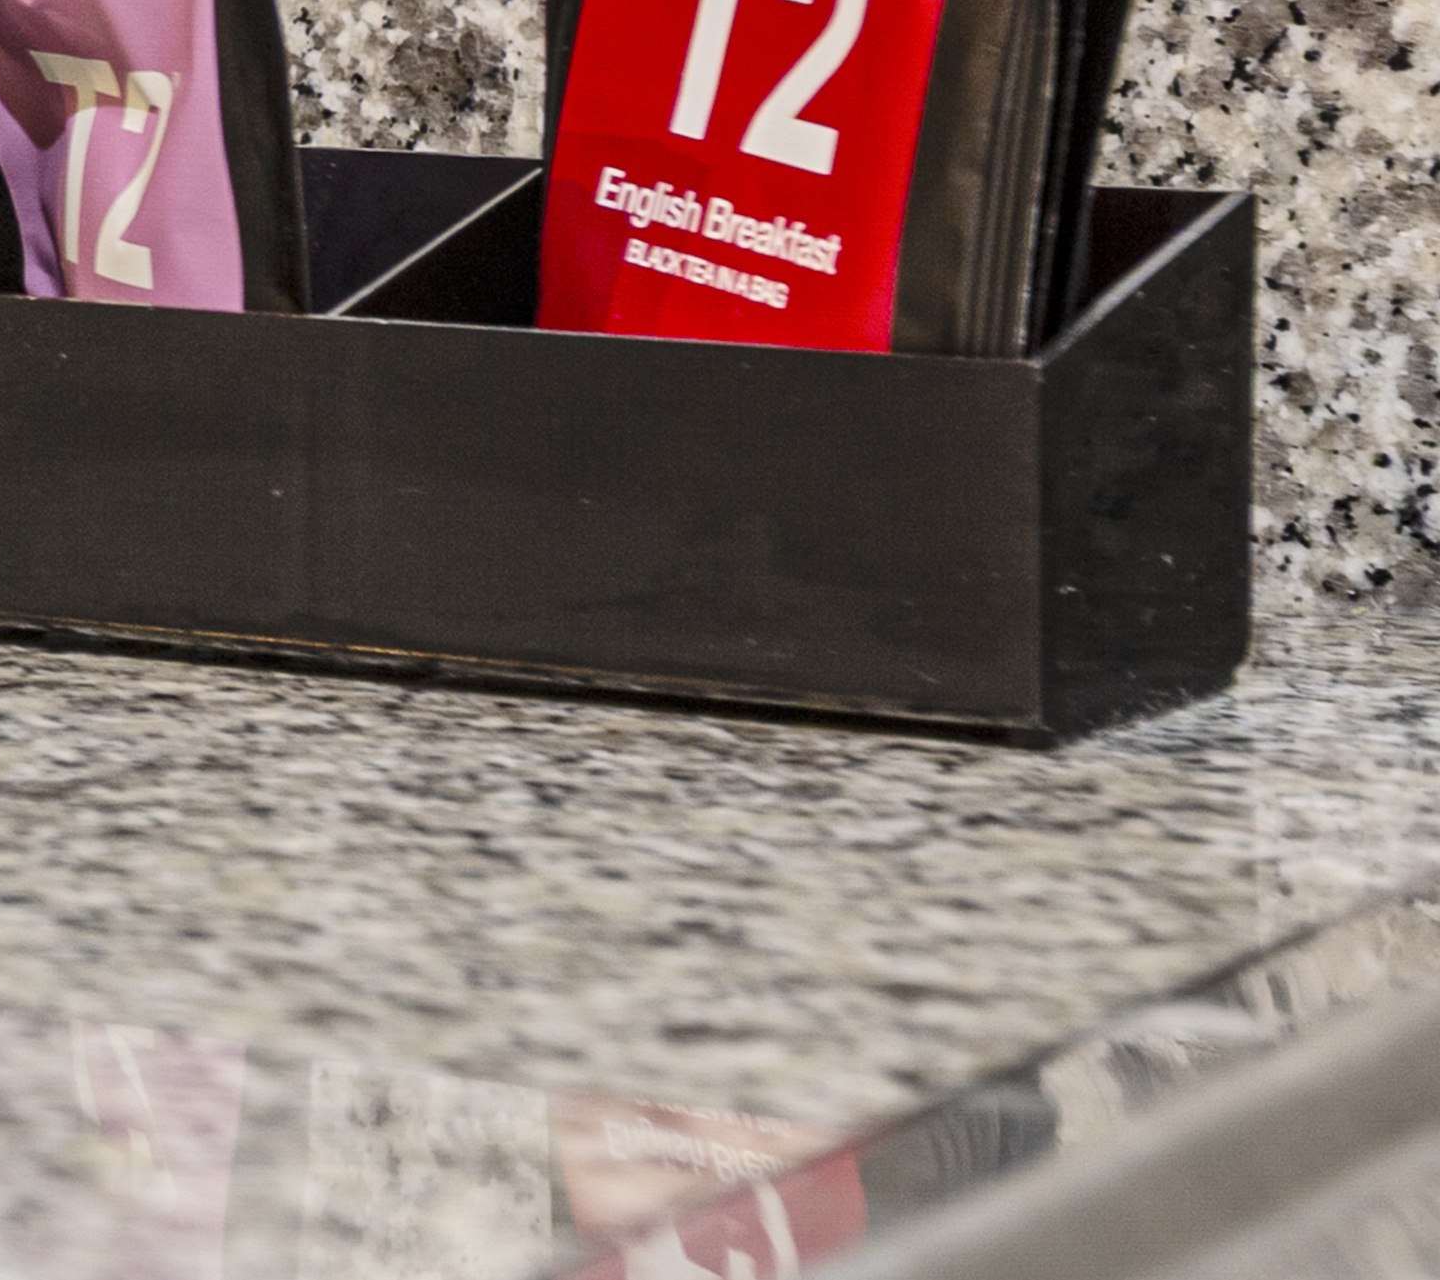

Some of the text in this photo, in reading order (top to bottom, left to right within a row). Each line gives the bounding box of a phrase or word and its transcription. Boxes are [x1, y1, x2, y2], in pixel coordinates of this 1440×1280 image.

[28, 49, 174, 290] T2
[594, 165, 843, 276] English Breakfast
[624, 237, 682, 276] BLACK
[681, 253, 717, 285] TEA
[748, 274, 791, 310] BAG
